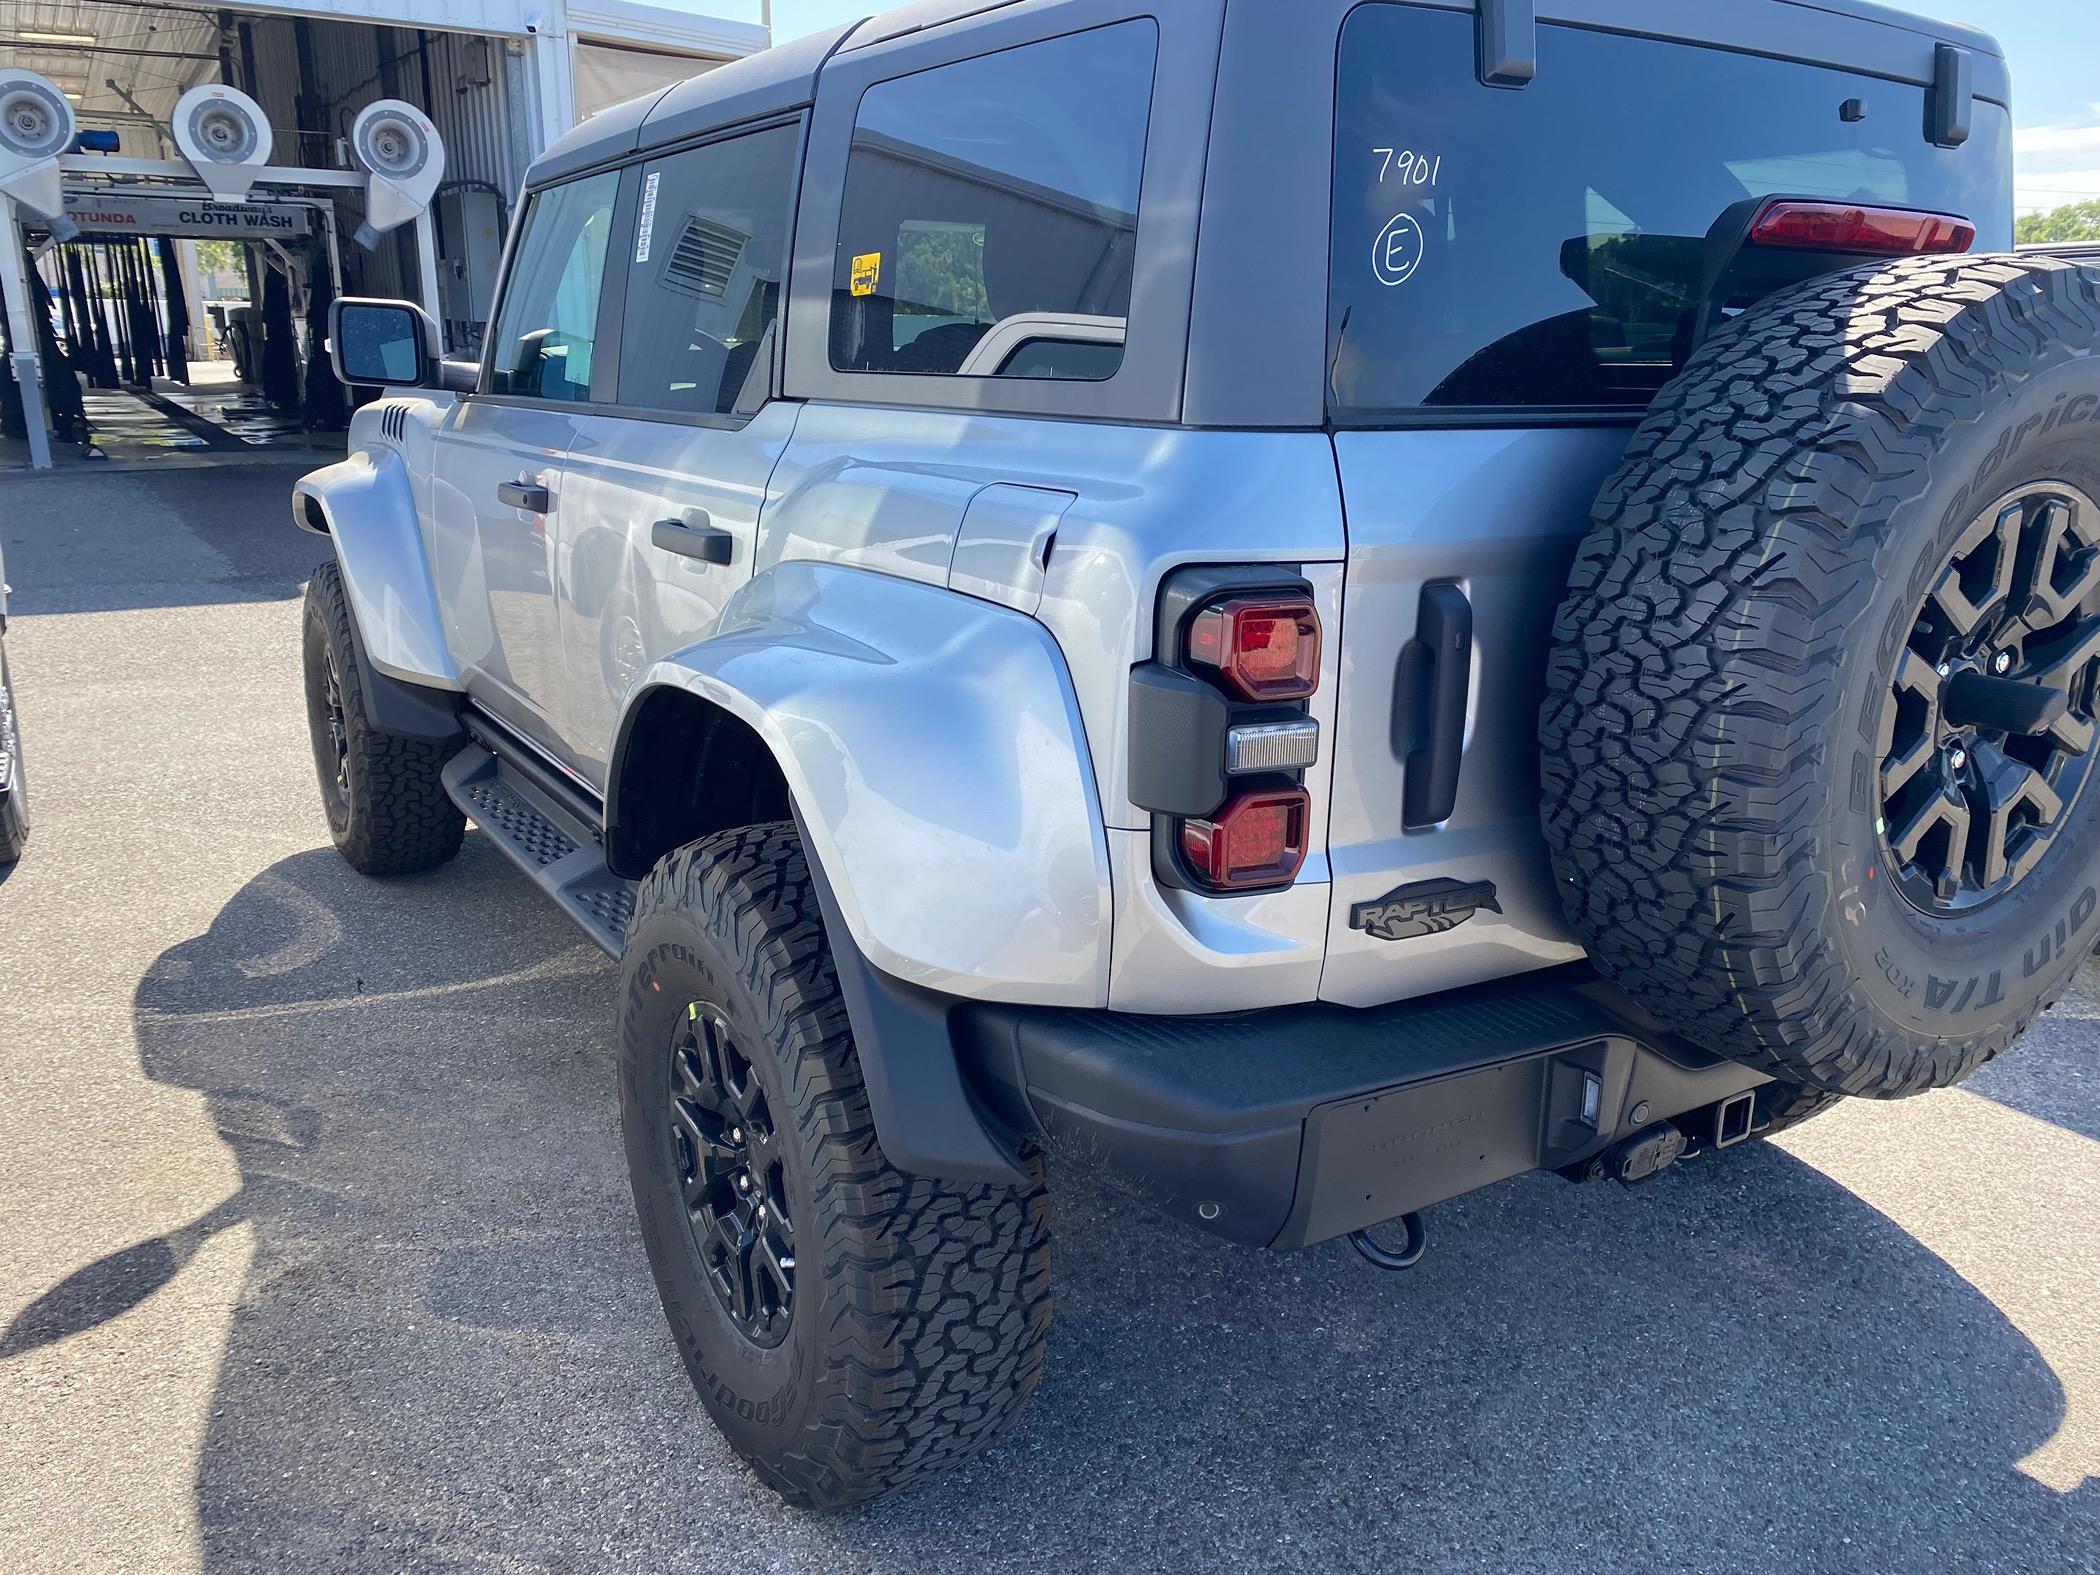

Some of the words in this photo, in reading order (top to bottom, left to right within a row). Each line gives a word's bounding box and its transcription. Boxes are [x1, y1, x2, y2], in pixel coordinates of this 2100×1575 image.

[1372, 148, 1441, 187] 7901
[66, 211, 137, 225] OTUNDA
[178, 211, 238, 226] CLOTH
[244, 214, 293, 228] WASH
[1849, 391, 2100, 815] BFGoodric
[1923, 968, 2006, 1014] T/A
